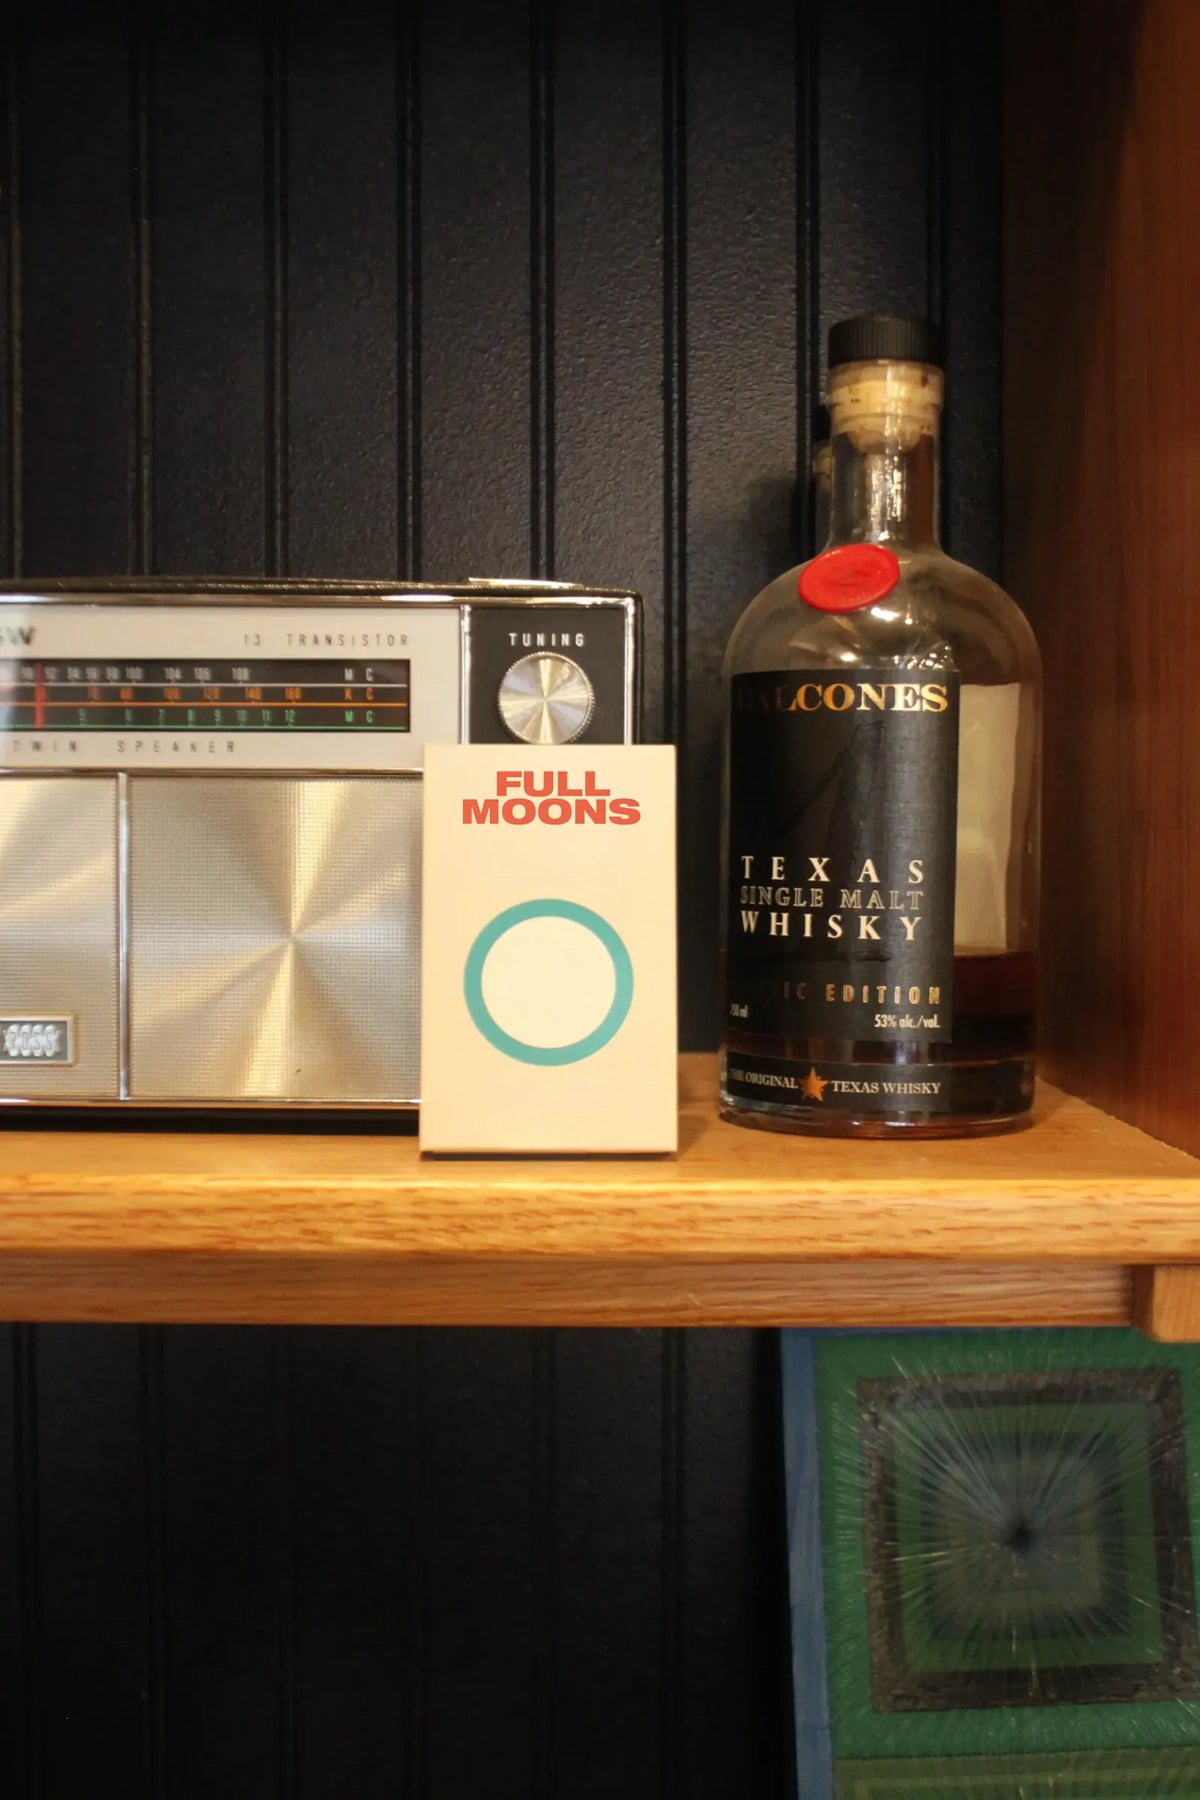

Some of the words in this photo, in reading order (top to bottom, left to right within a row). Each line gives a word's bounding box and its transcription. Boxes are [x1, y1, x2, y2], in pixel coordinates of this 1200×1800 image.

[244, 633, 261, 646] 13
[286, 633, 408, 646] TRANSISTOR
[508, 632, 585, 647] TUNING
[165, 667, 182, 680] 104
[737, 681, 949, 713] LCONES
[285, 709, 296, 722] 12
[12, 740, 77, 752] TWIN
[116, 740, 235, 753] SPEAKER
[496, 770, 611, 798] FULL
[462, 798, 642, 825] MOONS
[740, 855, 925, 884] TEXAS
[739, 885, 825, 908] SINGLE
[839, 889, 924, 910] MALT
[740, 910, 923, 941] WHISKY
[825, 983, 941, 1005] EDITION
[874, 1014, 897, 1028] 53%
[899, 1014, 941, 1029] alc./vol.
[745, 1071, 799, 1089] ORIGINAL
[831, 1080, 879, 1094] TEXAS
[882, 1082, 942, 1096] WHISKY
